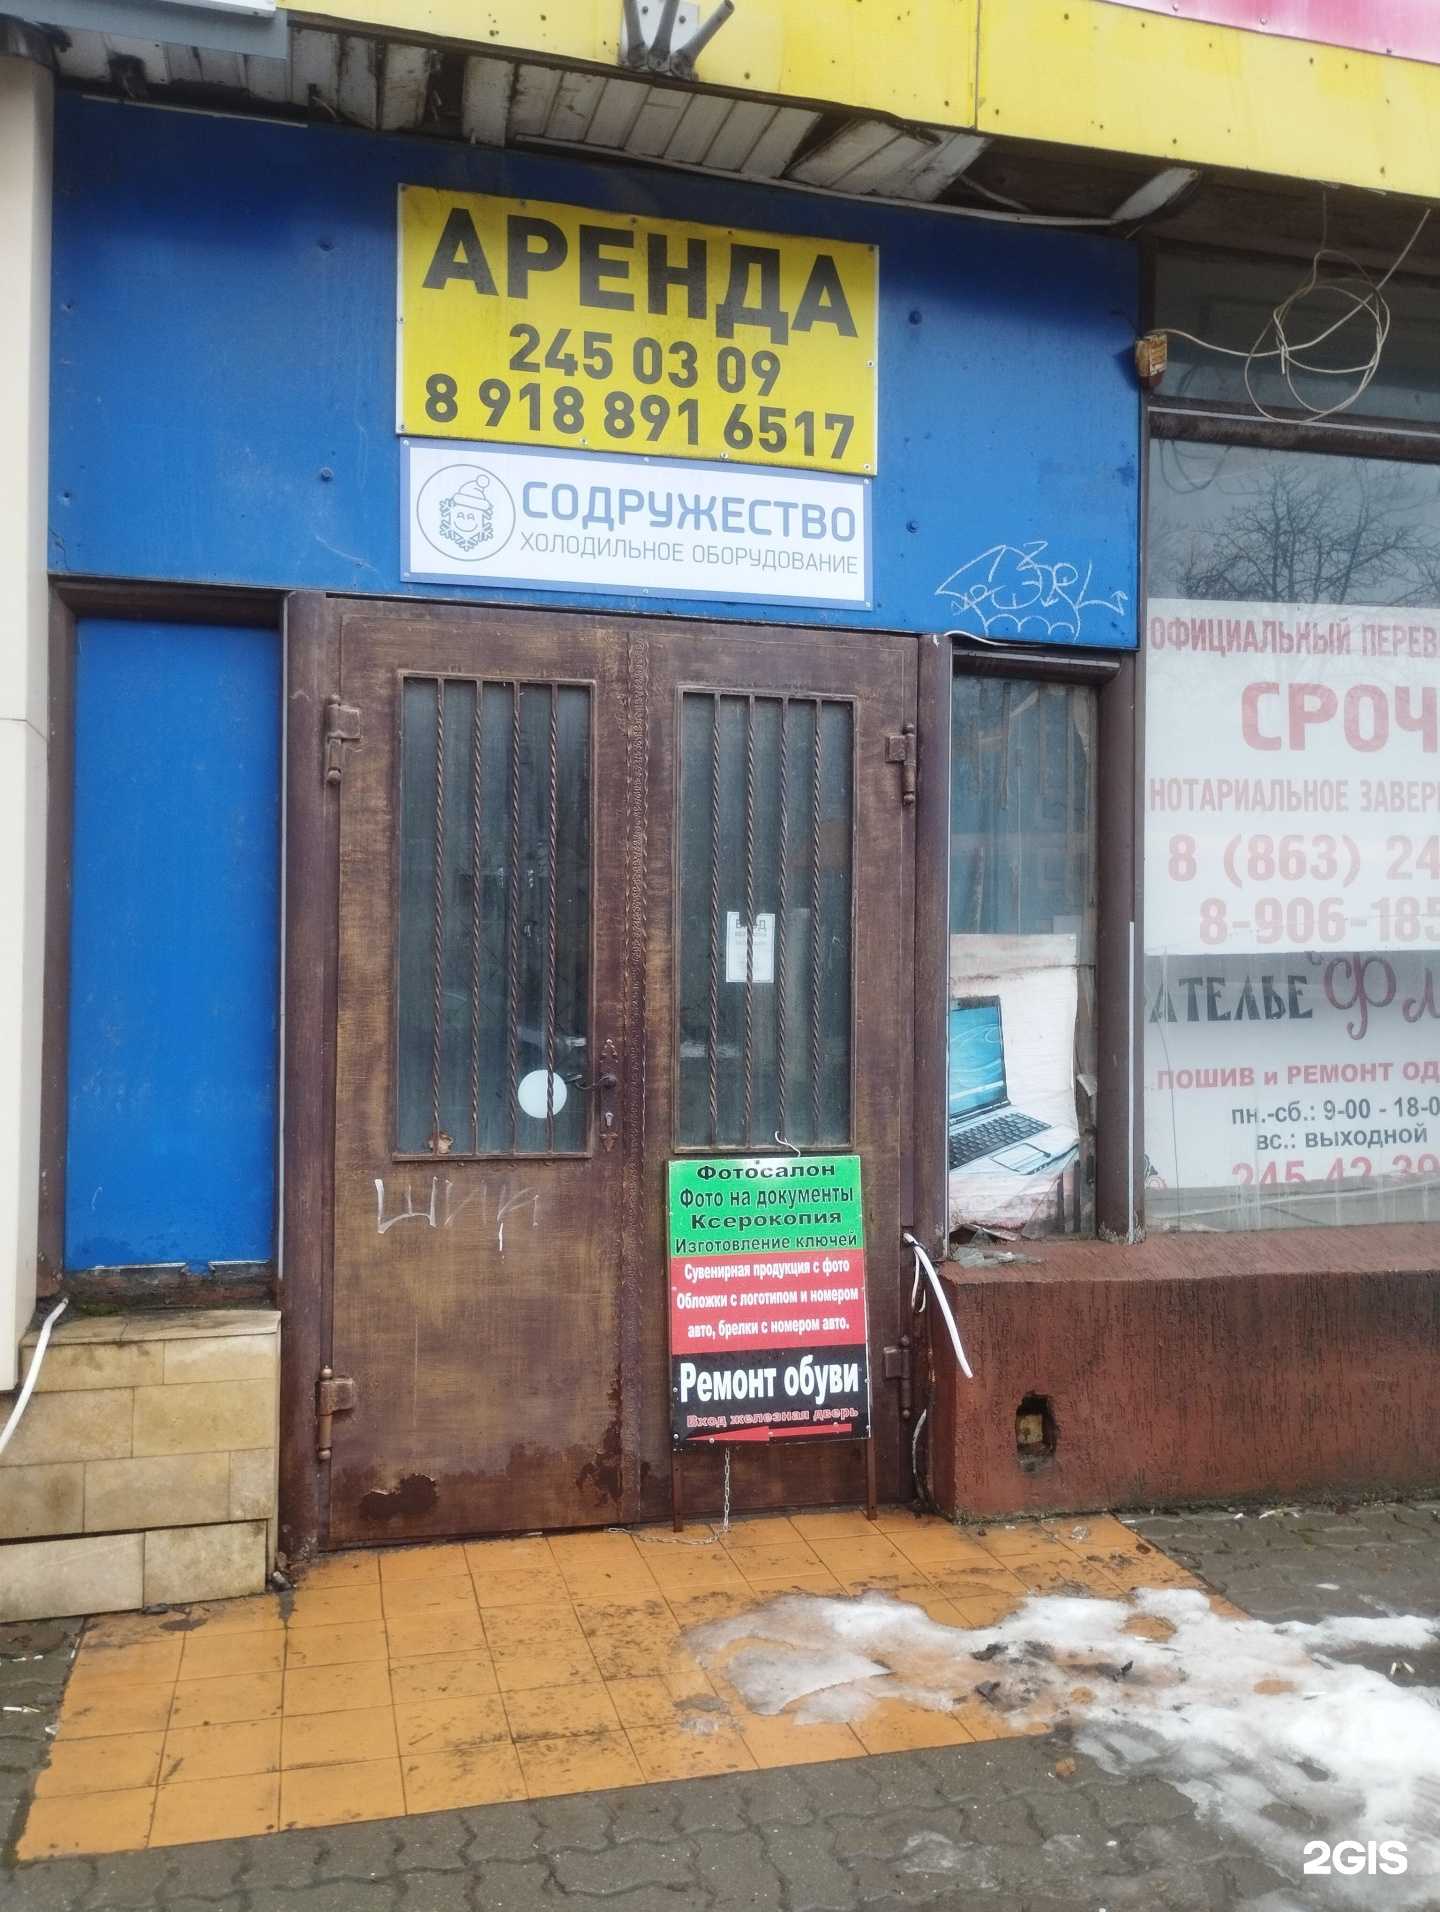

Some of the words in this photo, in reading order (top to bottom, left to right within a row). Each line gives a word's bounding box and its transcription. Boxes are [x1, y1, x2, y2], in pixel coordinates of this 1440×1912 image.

[422, 207, 858, 346] АРЕНДА
[508, 323, 614, 380] 245
[632, 336, 698, 389] 03
[716, 346, 781, 397] 09
[424, 373, 458, 423] 8
[478, 378, 585, 437] 918
[603, 391, 699, 446] 891
[722, 403, 855, 460] 6517
[522, 480, 856, 543] СОДРУЖЕСТВО
[519, 530, 684, 562] ХОЛОДИЛЬНОЕ
[692, 544, 858, 575] ОБОРУДОВАНИЕ
[1150, 616, 1351, 657] ОФИЦИАЛЬНЫЙ
[1241, 681, 1438, 753] СРОЧ
[1150, 777, 1348, 812] НОТАРИАЛЬНОЕ
[1359, 780, 1440, 813] ЗАВЕР
[1168, 833, 1197, 882] 8
[1223, 833, 1361, 888] (863)
[1386, 834, 1440, 880] 24
[1149, 974, 1312, 1022] АТЕЛЬЕ
[1156, 1067, 1255, 1090] ПОШИВ
[1264, 1071, 1278, 1086] и
[1287, 1062, 1394, 1085] РЕМОНТ
[1323, 1099, 1371, 1120] 9-00
[697, 1163, 836, 1181] Фотосалон
[680, 1188, 723, 1208] Фото
[730, 1193, 750, 1206] на
[757, 1186, 853, 1209] документы
[691, 1211, 842, 1231] Ксерокопия
[676, 1236, 790, 1254] Изготовление
[796, 1230, 857, 1249] ключей
[684, 1262, 750, 1284] Сувенирная
[753, 1259, 810, 1281] продукция
[813, 1262, 820, 1273] с
[822, 1257, 850, 1278] фото
[676, 1292, 728, 1310] Обложки
[730, 1295, 737, 1307] с
[740, 1292, 798, 1307] логотипом
[801, 1291, 808, 1302] и
[810, 1287, 859, 1305] номером
[687, 1324, 716, 1340] авто,
[718, 1320, 759, 1337] брелки
[761, 1322, 768, 1334] с
[770, 1319, 820, 1335] номером
[822, 1317, 850, 1330] авто.
[680, 1361, 777, 1403] Ремонт
[784, 1354, 859, 1405] обуви
[686, 1414, 727, 1428] Вход
[730, 1409, 810, 1425] железная
[813, 1406, 859, 1422] дверь
